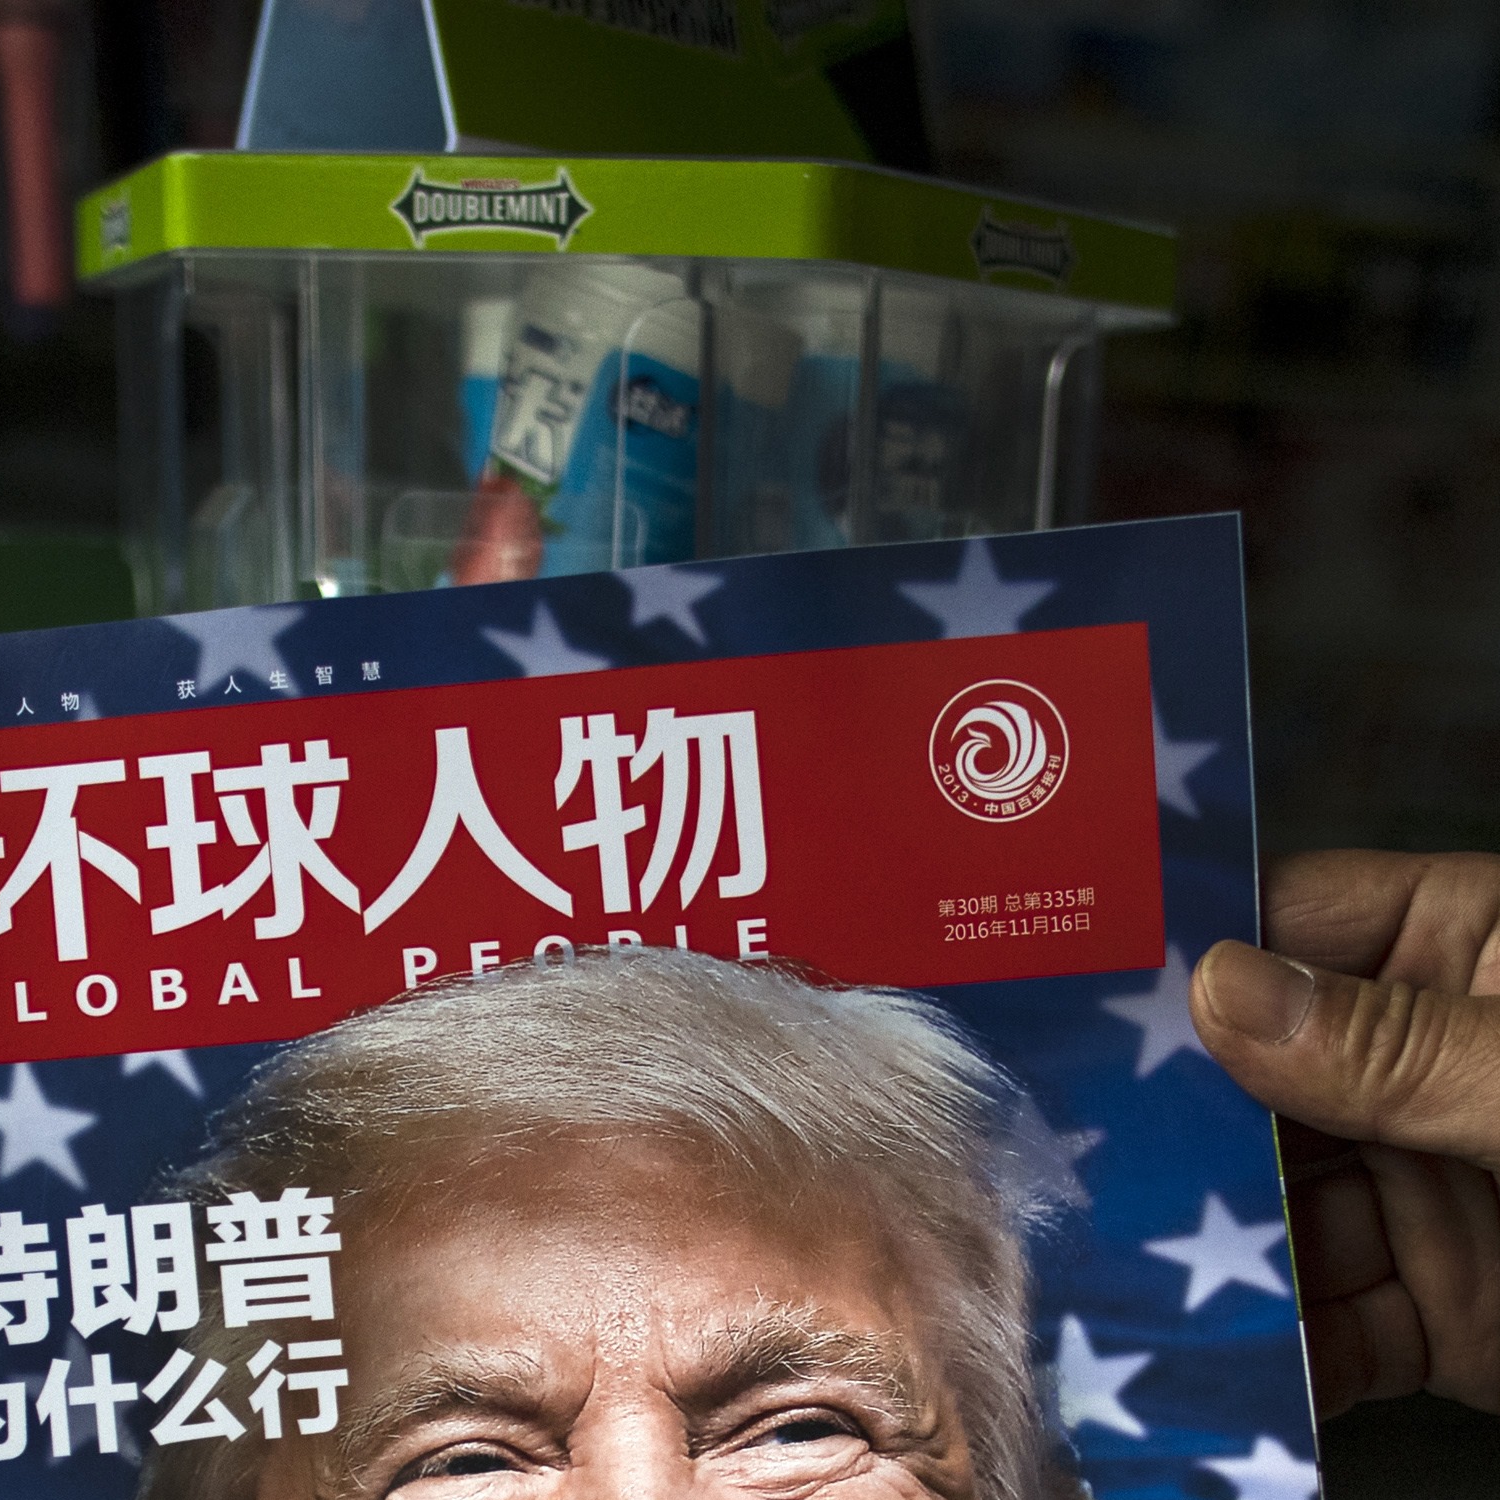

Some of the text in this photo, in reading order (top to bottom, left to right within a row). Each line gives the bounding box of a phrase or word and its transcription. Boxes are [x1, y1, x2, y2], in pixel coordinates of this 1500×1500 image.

[411, 189, 570, 225] DOUBLEMINT
[177, 660, 382, 699] 获人生智慧
[938, 887, 1095, 918] 第30期 总第335期
[944, 912, 1090, 942] 2016年11月16日
